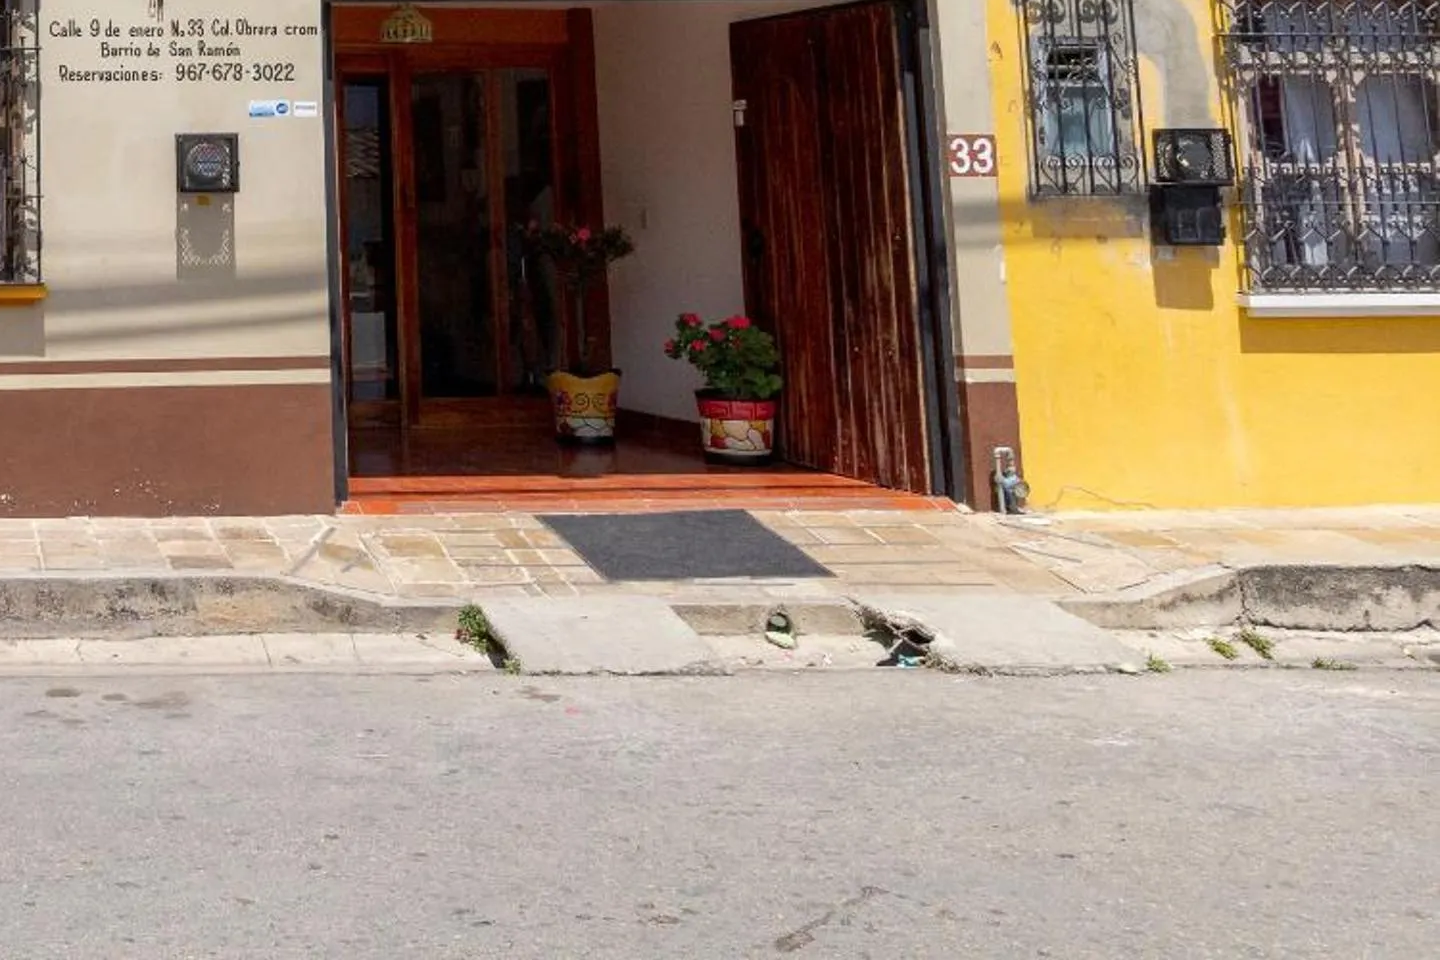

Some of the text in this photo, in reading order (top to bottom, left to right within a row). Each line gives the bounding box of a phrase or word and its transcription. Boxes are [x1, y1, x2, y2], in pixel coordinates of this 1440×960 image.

[49, 20, 82, 37] Calle
[89, 18, 100, 37] 9
[105, 20, 120, 37] de
[128, 26, 164, 37] enero
[284, 25, 318, 36] crom
[100, 39, 241, 57] Barrio de San Ramón
[58, 64, 163, 81] Reservaciones:
[949, 138, 993, 174] 33
